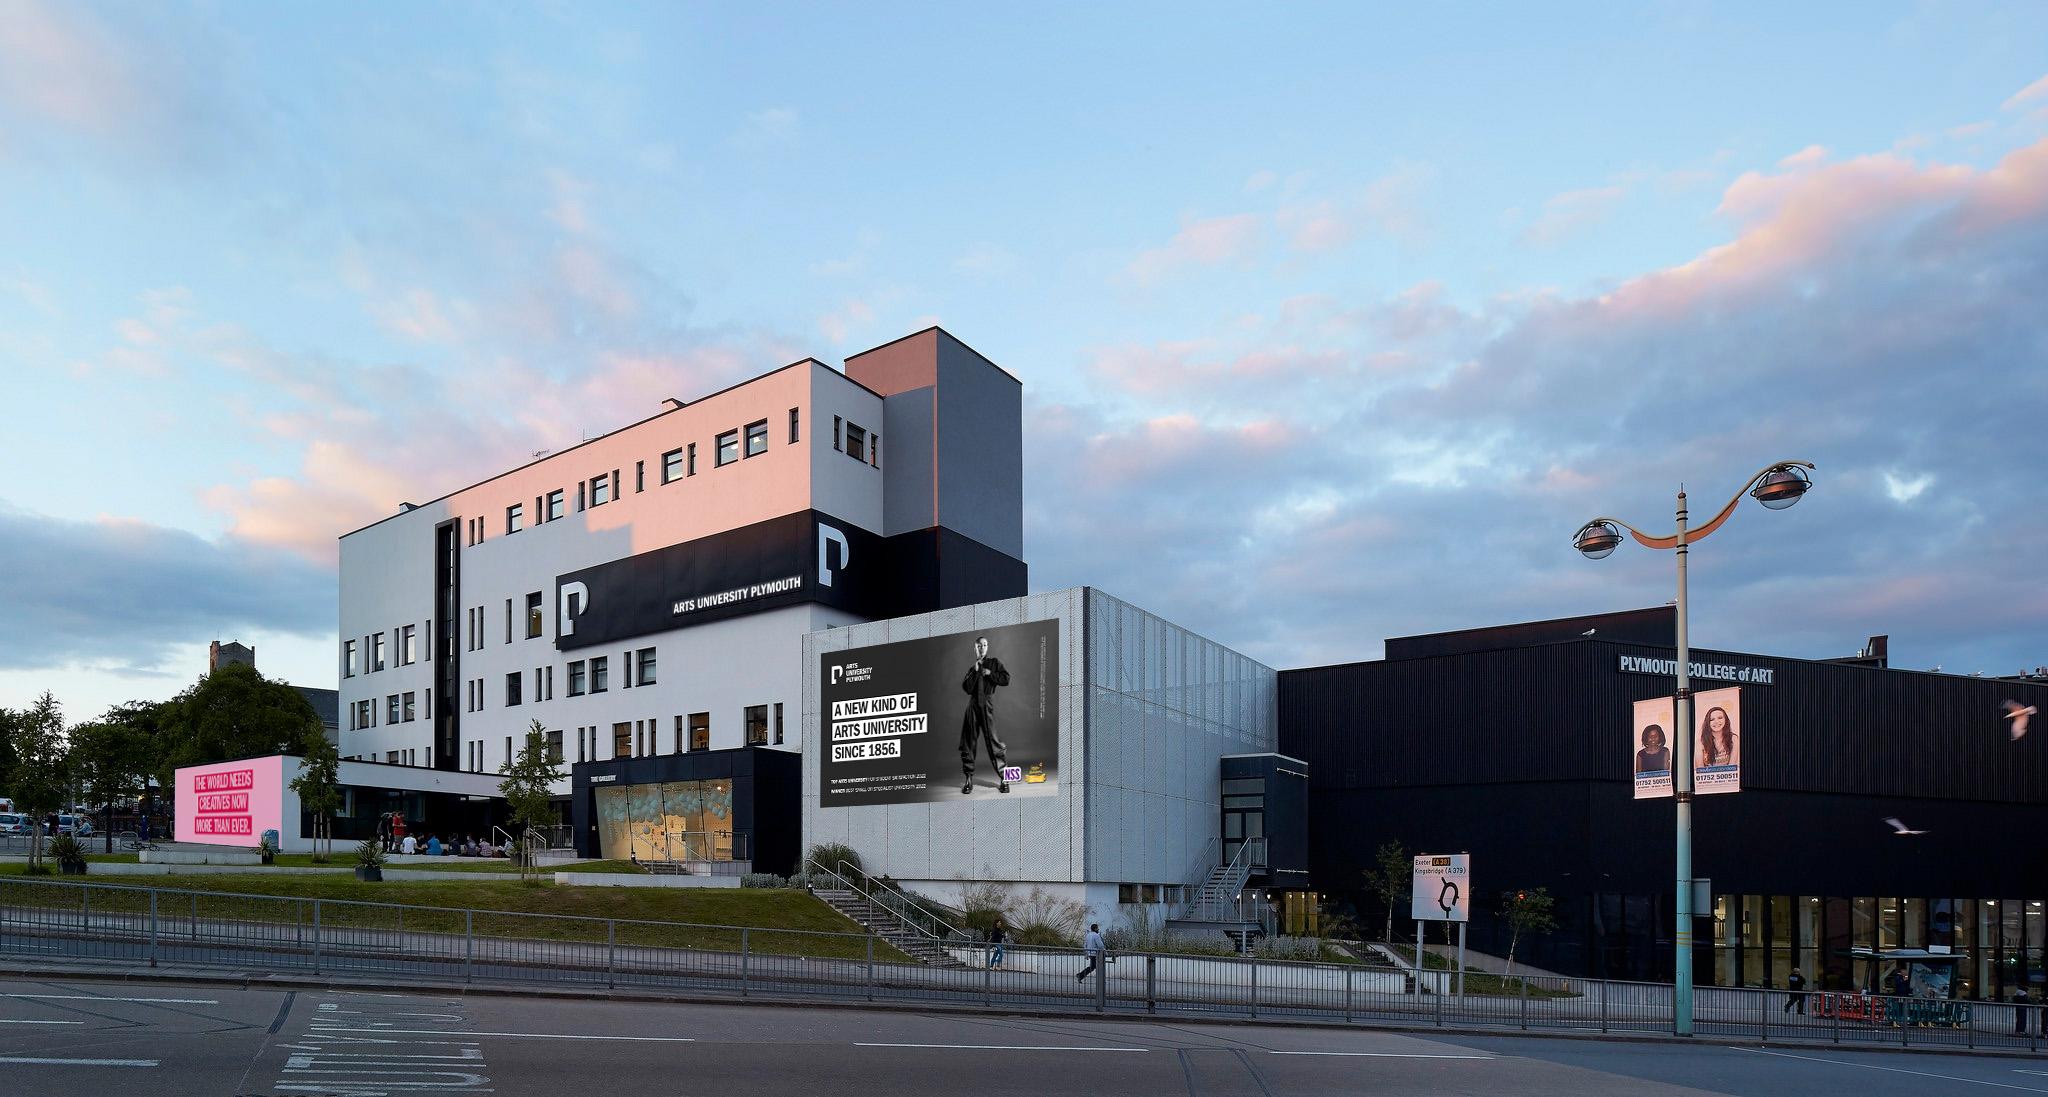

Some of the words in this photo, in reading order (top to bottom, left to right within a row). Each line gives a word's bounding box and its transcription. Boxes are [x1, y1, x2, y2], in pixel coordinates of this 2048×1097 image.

[673, 599, 695, 614] ARTS
[697, 588, 748, 610] UNIVERSITY
[750, 576, 801, 598] PLYMOUTH
[846, 667, 872, 676] UNIVERSITY
[1620, 656, 1678, 676] PLYMOUT
[1688, 662, 1736, 680] COLLEGE
[1738, 668, 1750, 681] of
[1752, 668, 1773, 684] ART
[834, 704, 842, 716] A
[845, 700, 868, 715] NEW
[871, 698, 897, 712] KIND
[900, 695, 915, 709] OF
[834, 723, 860, 738] ARTS
[863, 716, 925, 735] UNIVERSITY
[835, 744, 865, 759] SINCE
[869, 742, 898, 756] 1856.
[196, 776, 206, 790] THE
[207, 774, 228, 789] WORLD
[229, 772, 251, 788] NEEDS
[1005, 768, 1020, 780] NSS
[199, 796, 230, 810] CREATIVES
[232, 794, 247, 809] NOW
[196, 819, 212, 832] MORE
[214, 818, 230, 832] THAN
[232, 818, 250, 832] EVER.
